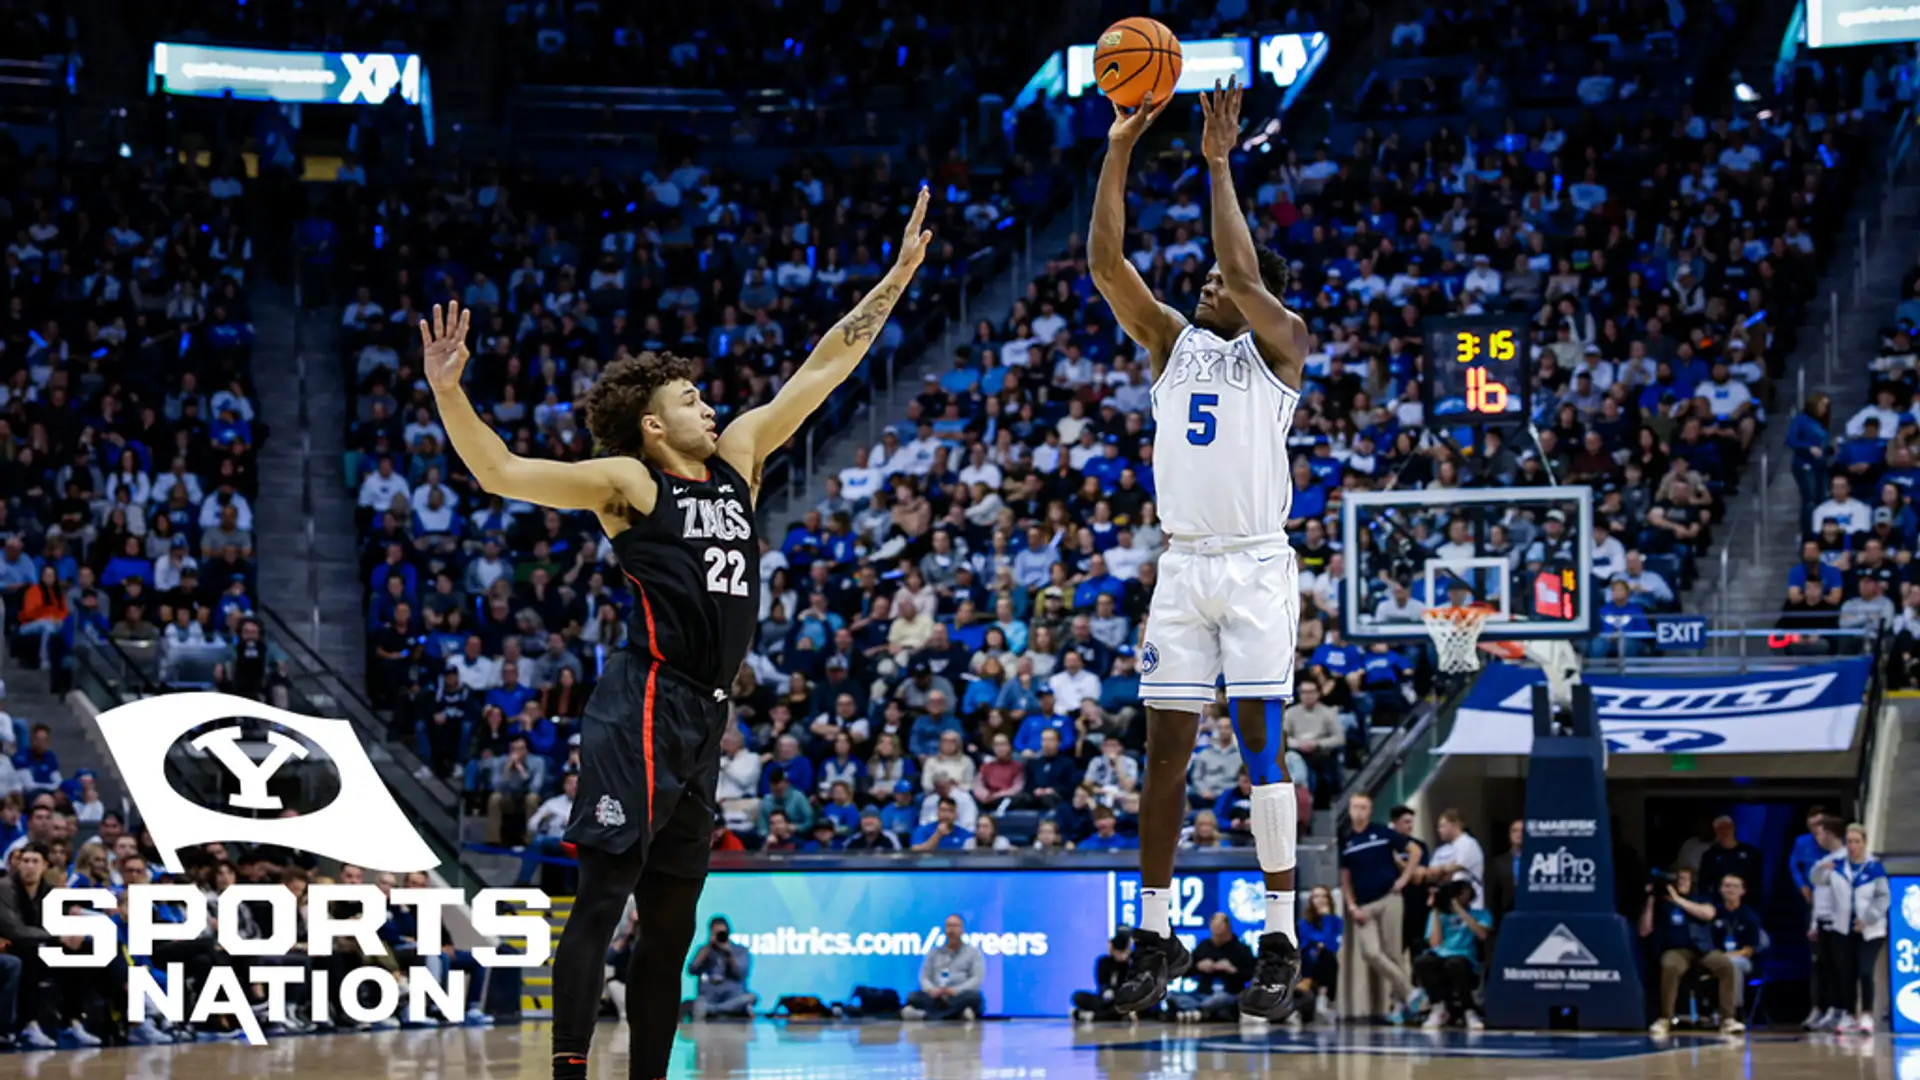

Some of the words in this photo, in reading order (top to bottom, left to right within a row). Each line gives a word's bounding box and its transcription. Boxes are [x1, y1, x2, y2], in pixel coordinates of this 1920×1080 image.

[1171, 350, 1252, 392] BYU
[1466, 366, 1508, 414] 16
[1185, 393, 1219, 446] 5
[677, 497, 751, 541] ZAGS
[704, 546, 749, 597] 22
[1656, 621, 1703, 644] EXIT
[730, 927, 1048, 957] ualtrics.com/reers
